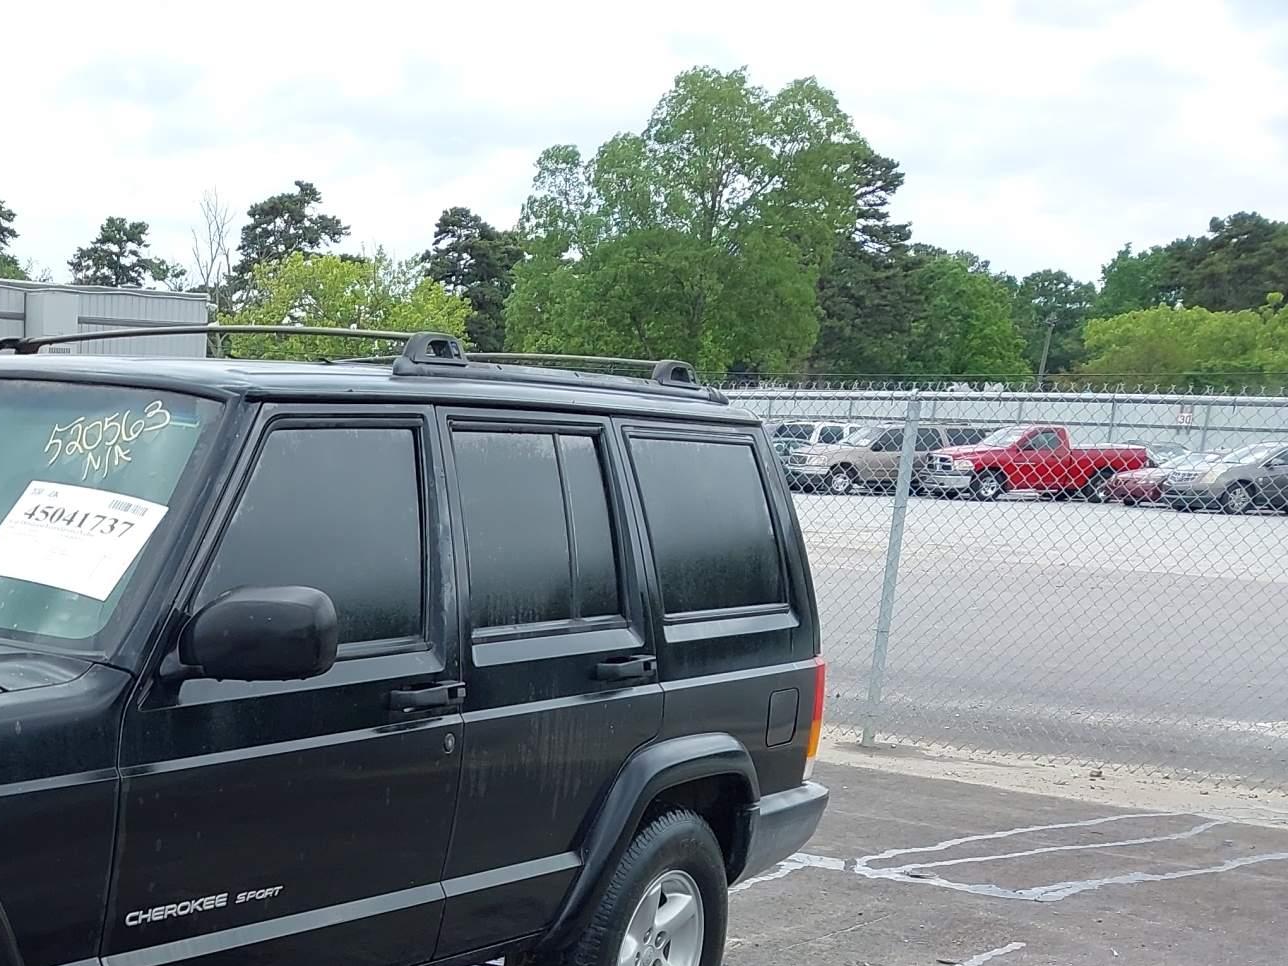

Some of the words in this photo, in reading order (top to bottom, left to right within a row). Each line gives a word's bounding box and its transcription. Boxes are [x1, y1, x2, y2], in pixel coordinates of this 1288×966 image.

[44, 400, 170, 465] 520563
[24, 504, 135, 538] 45041737
[125, 893, 228, 926] CHEROKEE
[235, 886, 283, 904] SPORT
